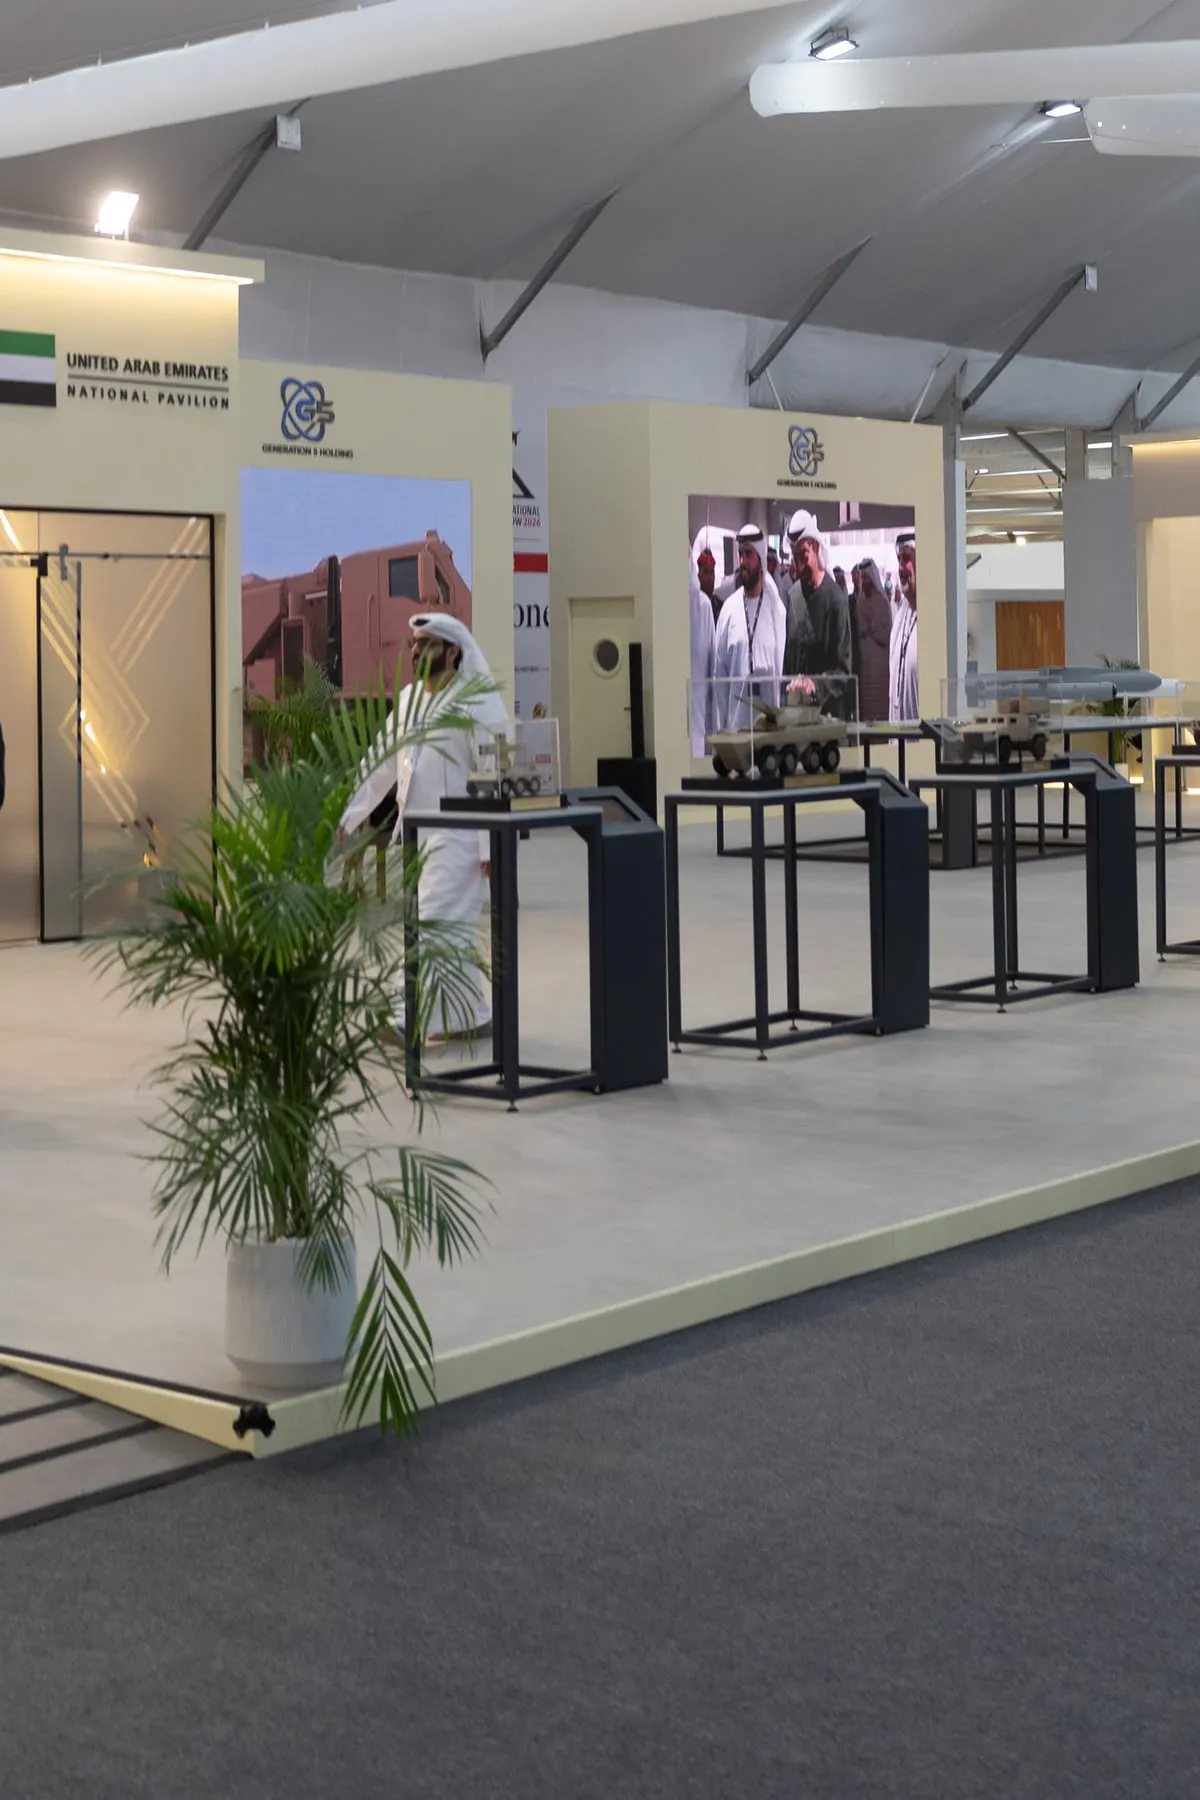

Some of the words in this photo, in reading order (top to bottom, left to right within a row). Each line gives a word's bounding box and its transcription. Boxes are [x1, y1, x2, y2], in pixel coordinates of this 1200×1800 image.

[66, 352, 118, 372] UNITED
[123, 359, 161, 375] ARAB
[164, 362, 229, 382] EMIRATES
[67, 384, 150, 402] NATIONAL
[158, 392, 230, 409] PAVILION
[262, 443, 312, 456] GENERATION
[313, 447, 318, 457] 5
[319, 448, 353, 459] HOLDING
